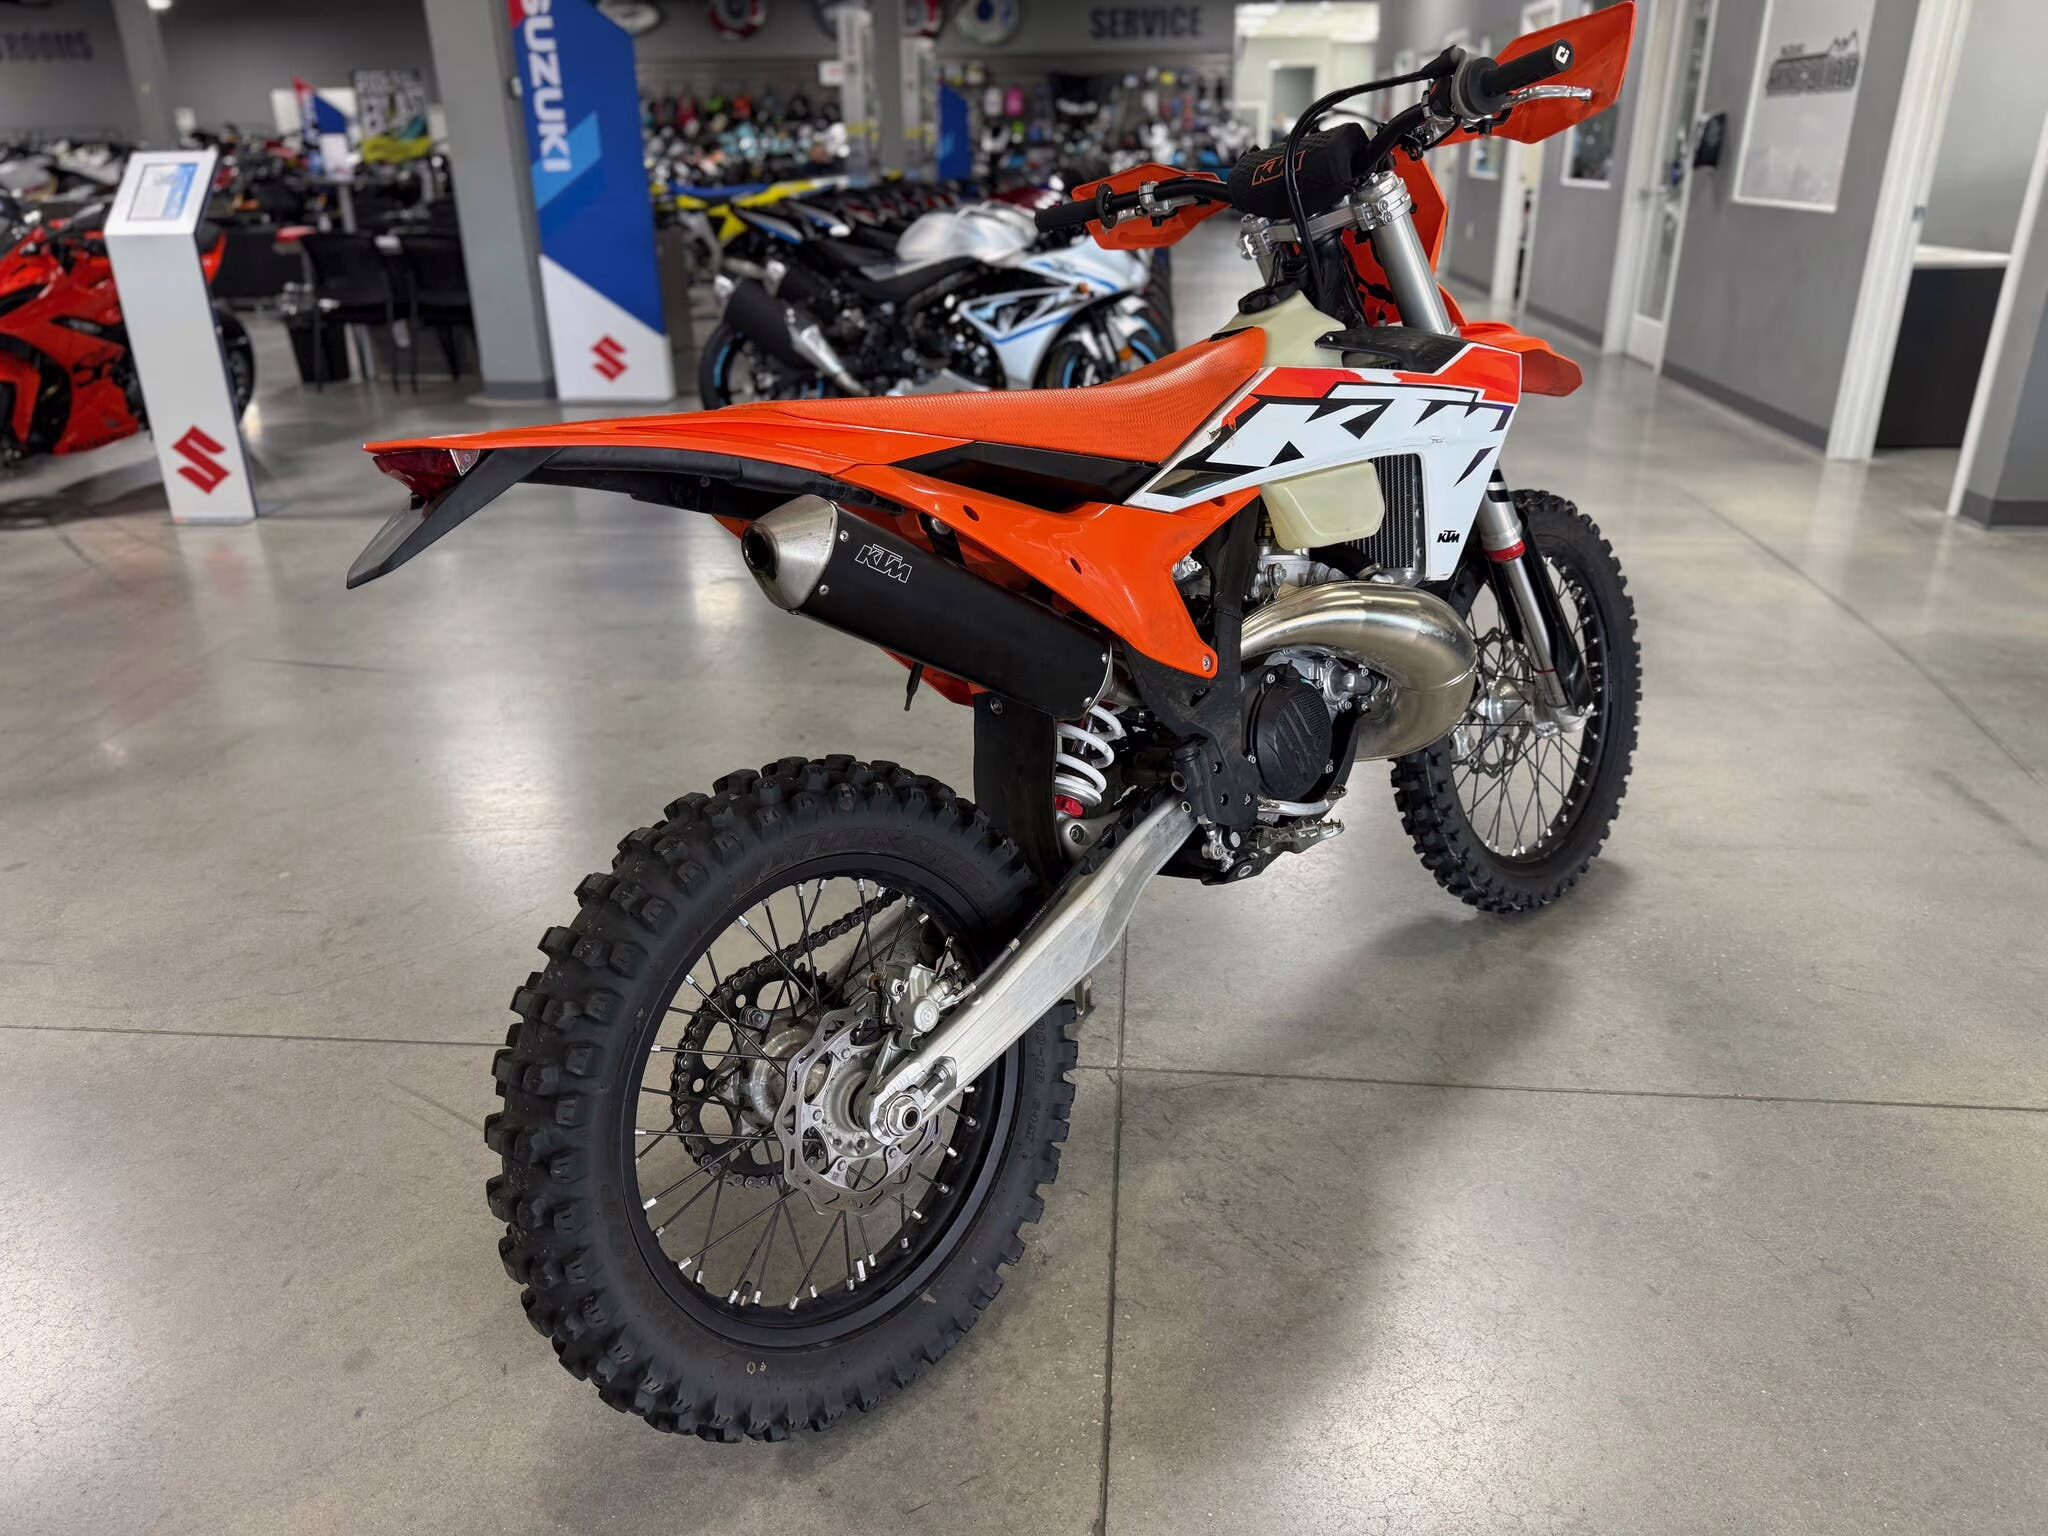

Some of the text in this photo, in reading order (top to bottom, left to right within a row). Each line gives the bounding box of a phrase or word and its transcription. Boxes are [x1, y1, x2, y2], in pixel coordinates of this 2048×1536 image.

[1089, 6, 1202, 39] SERVICE
[1437, 529, 1460, 543] KTM
[855, 543, 913, 584] KTM
